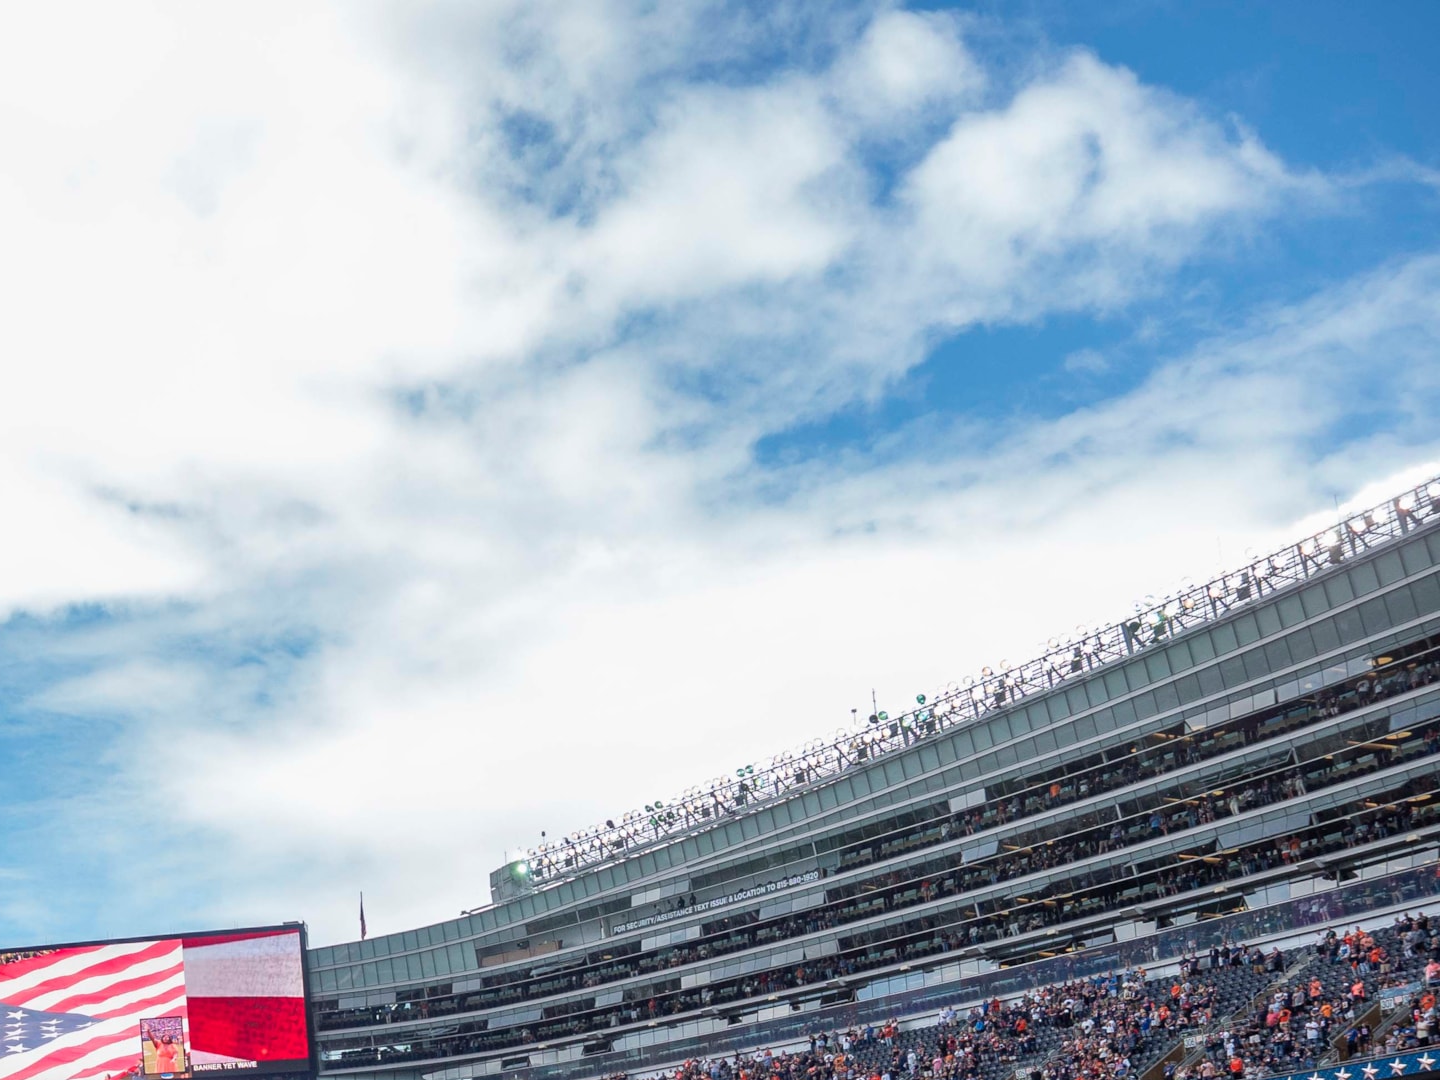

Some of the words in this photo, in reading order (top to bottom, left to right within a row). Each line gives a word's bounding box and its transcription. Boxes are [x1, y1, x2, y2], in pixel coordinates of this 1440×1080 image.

[613, 925, 626, 934] FOR
[694, 902, 710, 912] TEXT
[710, 897, 728, 908] ISSUE
[734, 886, 766, 901] LOCATION
[767, 882, 776, 891] TO
[193, 1063, 222, 1072] BANNER
[223, 1062, 236, 1070] YET
[237, 1061, 258, 1069] WAVE
